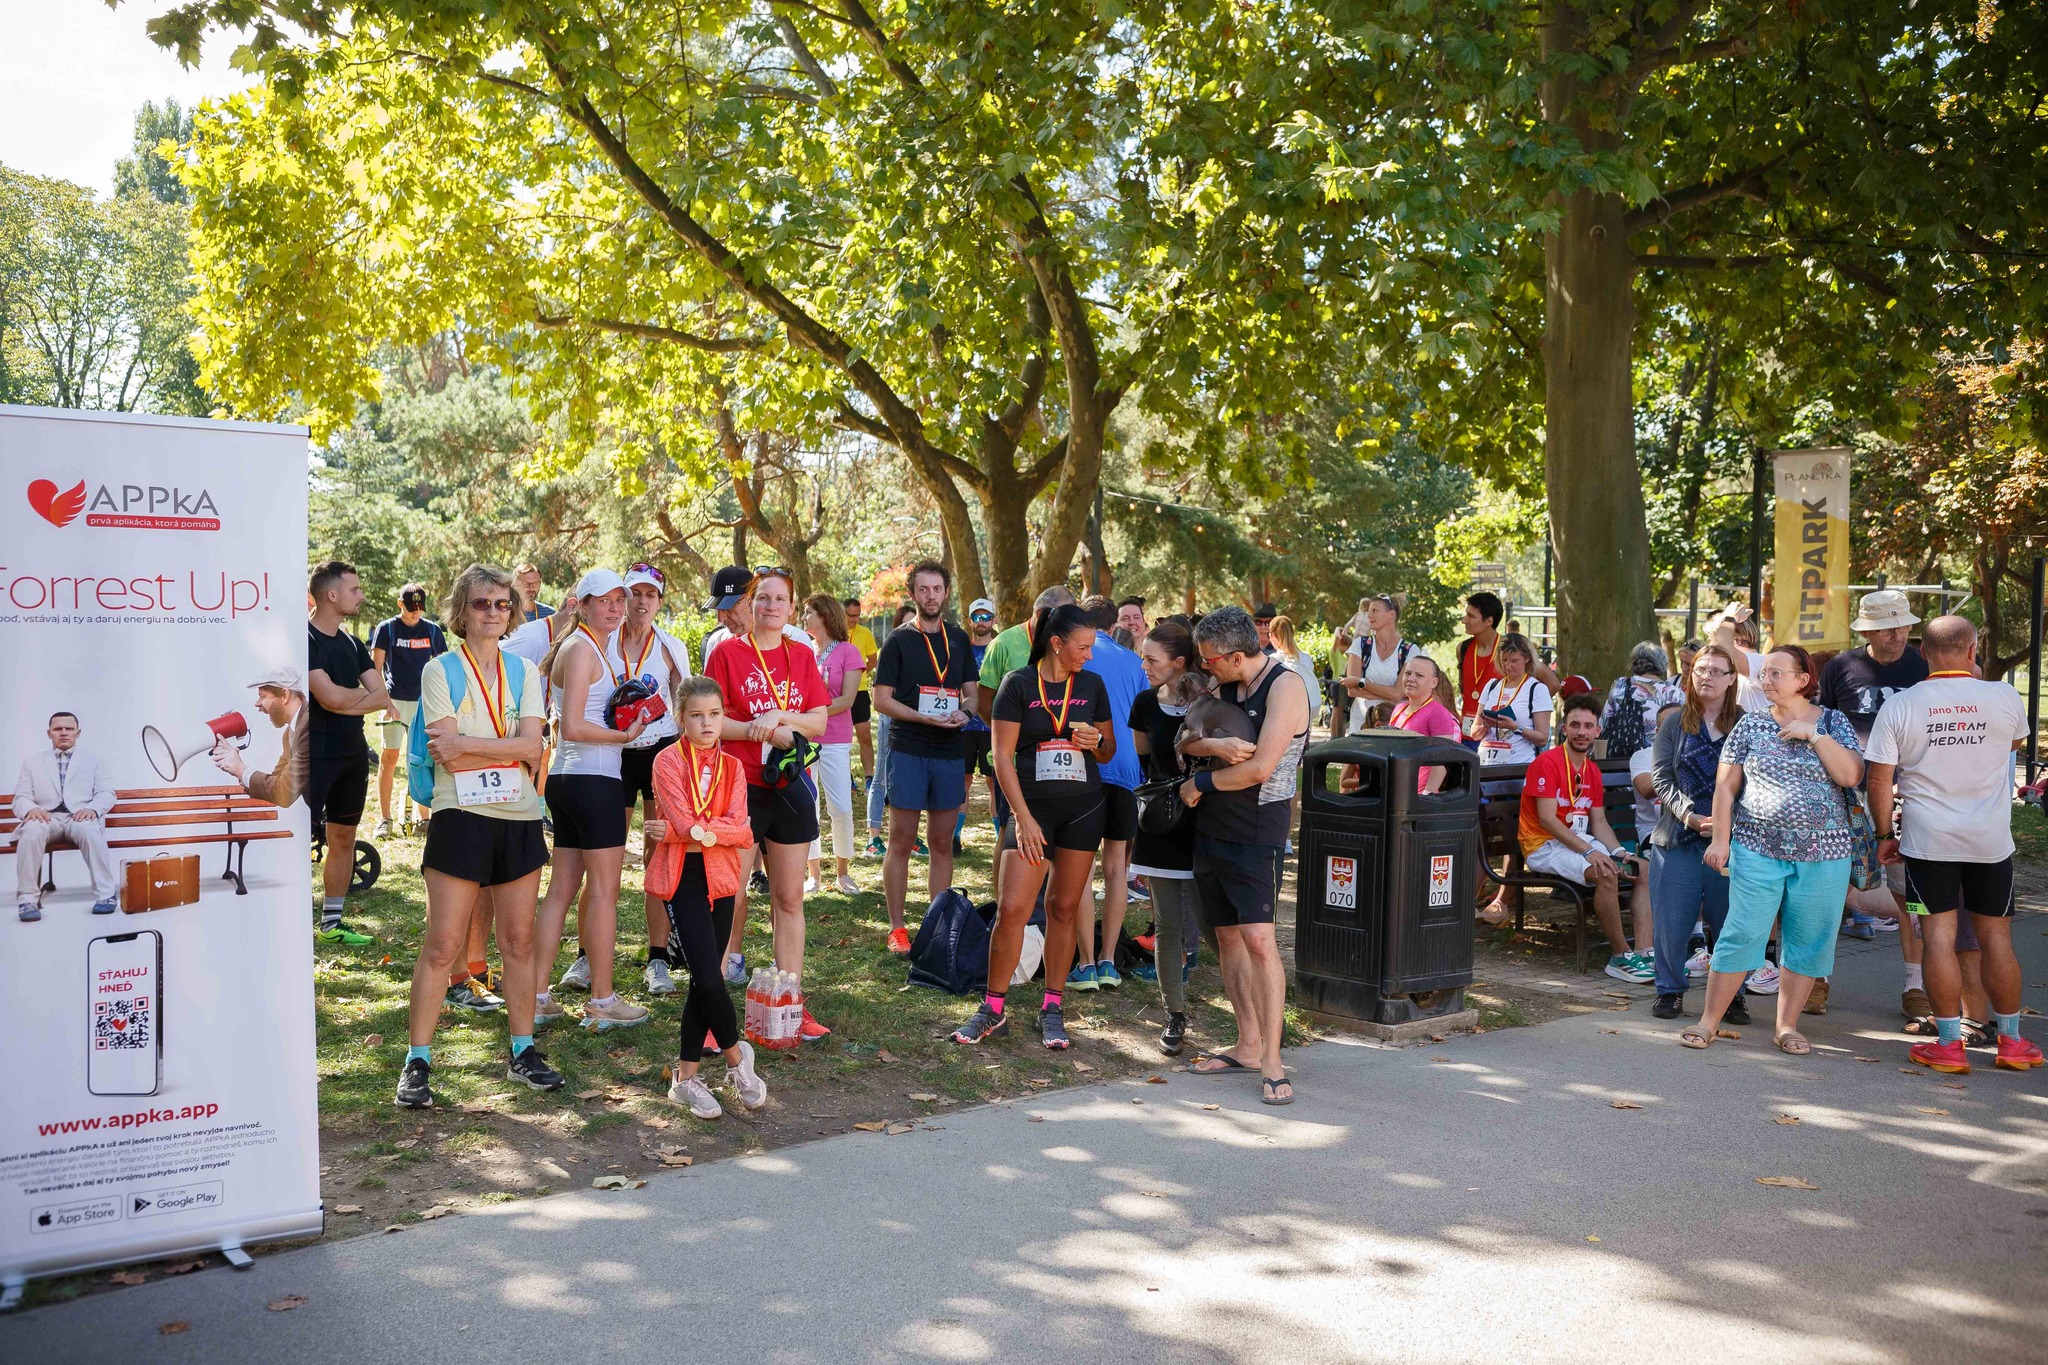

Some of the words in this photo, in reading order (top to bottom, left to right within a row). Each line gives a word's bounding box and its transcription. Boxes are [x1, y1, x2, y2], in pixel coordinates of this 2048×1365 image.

[1784, 472, 1842, 481] PLANETKA
[89, 484, 219, 516] APPkA
[90, 517, 111, 526] prvá
[113, 518, 153, 527] aplikácia,
[155, 519, 179, 527] ktorá
[181, 520, 217, 529] pomáha
[1799, 496, 1828, 641] FITPARK
[189, 570, 270, 619] Up!
[23, 614, 60, 624] vstávaj
[62, 614, 71, 625] aj
[73, 615, 84, 625] ty
[95, 615, 121, 625] daruj
[123, 615, 161, 625] energiu
[163, 616, 175, 624] na
[177, 615, 207, 624] dobrú
[208, 616, 228, 624] vec.
[934, 697, 948, 710] 23
[1928, 707, 1952, 717] Jano
[1954, 705, 1978, 714] TAXI
[1926, 721, 1987, 734] ZBIERAM
[1928, 734, 1987, 747] MEDAILY
[1053, 752, 1073, 767] 49
[1487, 748, 1499, 759] 17
[478, 771, 502, 788] 13
[1330, 891, 1354, 907] 070
[1431, 891, 1449, 905] 070
[98, 966, 148, 981] SŤAHUJ
[98, 981, 133, 994] HNEĎ
[38, 1102, 219, 1137] www.appka.app
[118, 1138, 131, 1147] ani
[131, 1137, 154, 1146] jeden
[156, 1133, 172, 1142] tvoj
[173, 1131, 191, 1139] krok
[193, 1126, 224, 1137] nevyjde
[115, 1173, 146, 1182] svojmu
[147, 1168, 178, 1179] pohybu
[179, 1164, 199, 1173] nový
[200, 1159, 231, 1170] zmysel!
[157, 1195, 195, 1209] Google
[196, 1192, 217, 1203] Play
[57, 1214, 82, 1225] App
[84, 1209, 115, 1220] Store
